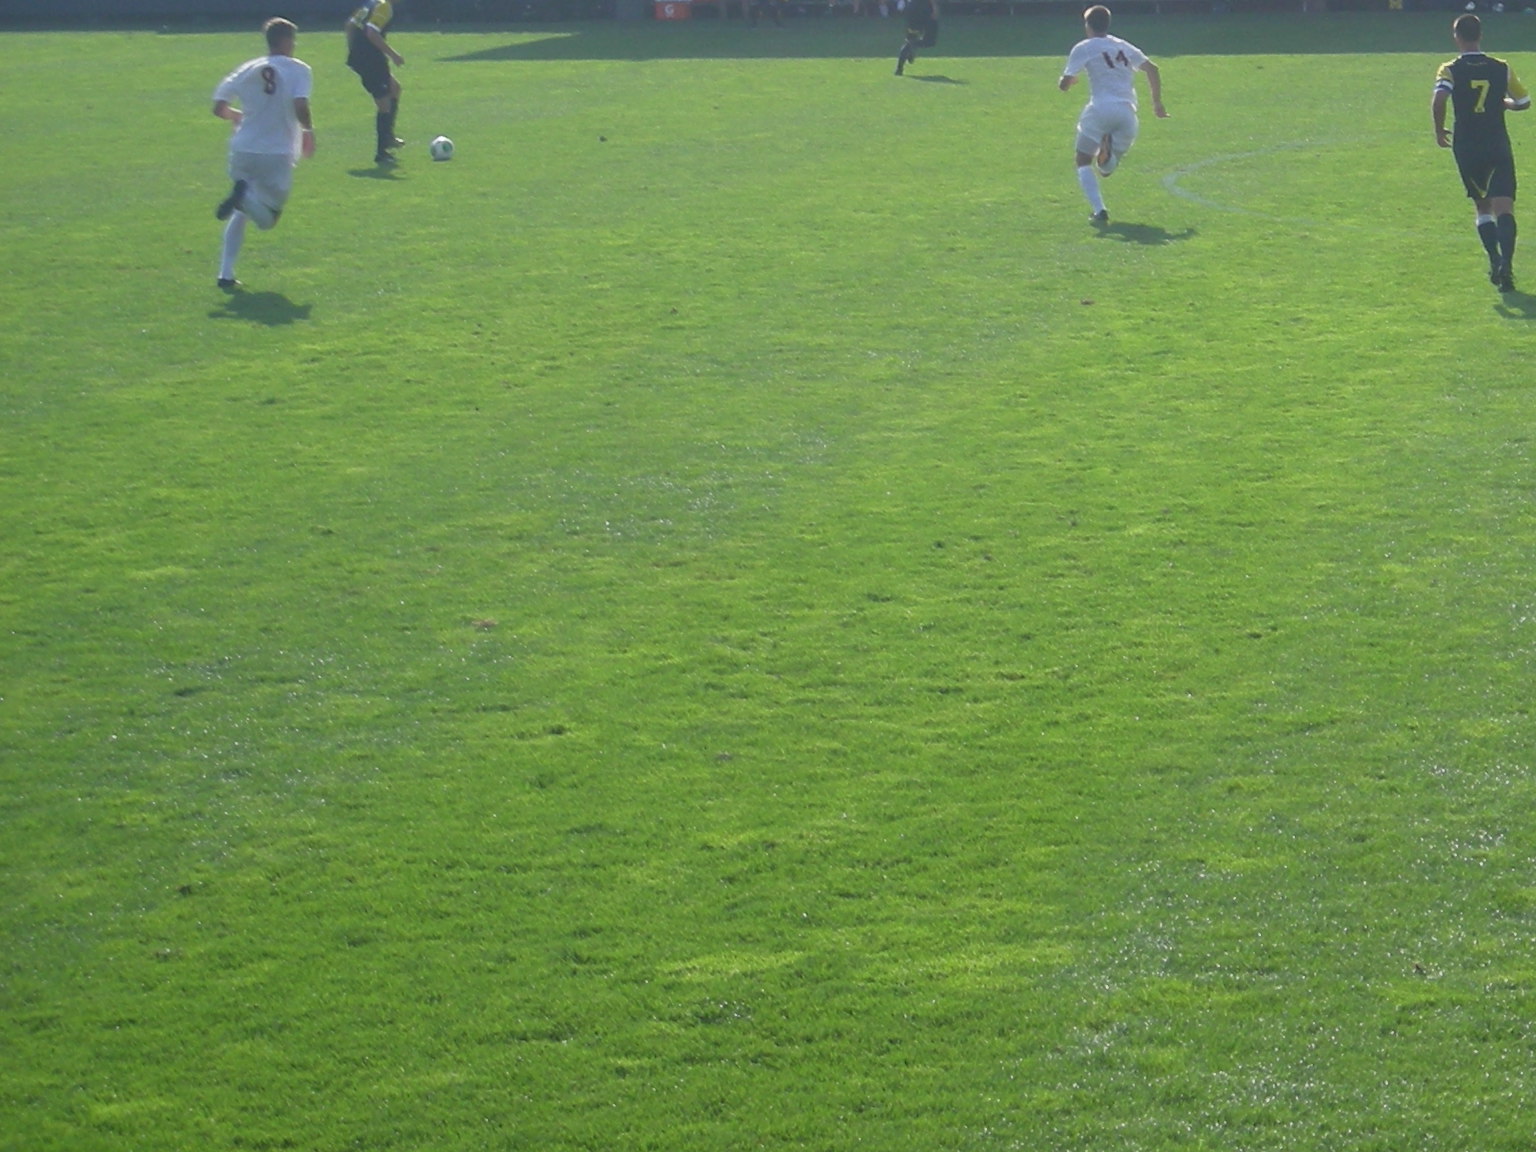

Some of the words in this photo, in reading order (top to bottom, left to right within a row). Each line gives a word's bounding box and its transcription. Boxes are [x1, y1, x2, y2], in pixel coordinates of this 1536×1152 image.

[1102, 50, 1129, 68] 14
[262, 67, 276, 94] 8
[1470, 79, 1490, 113] 7
